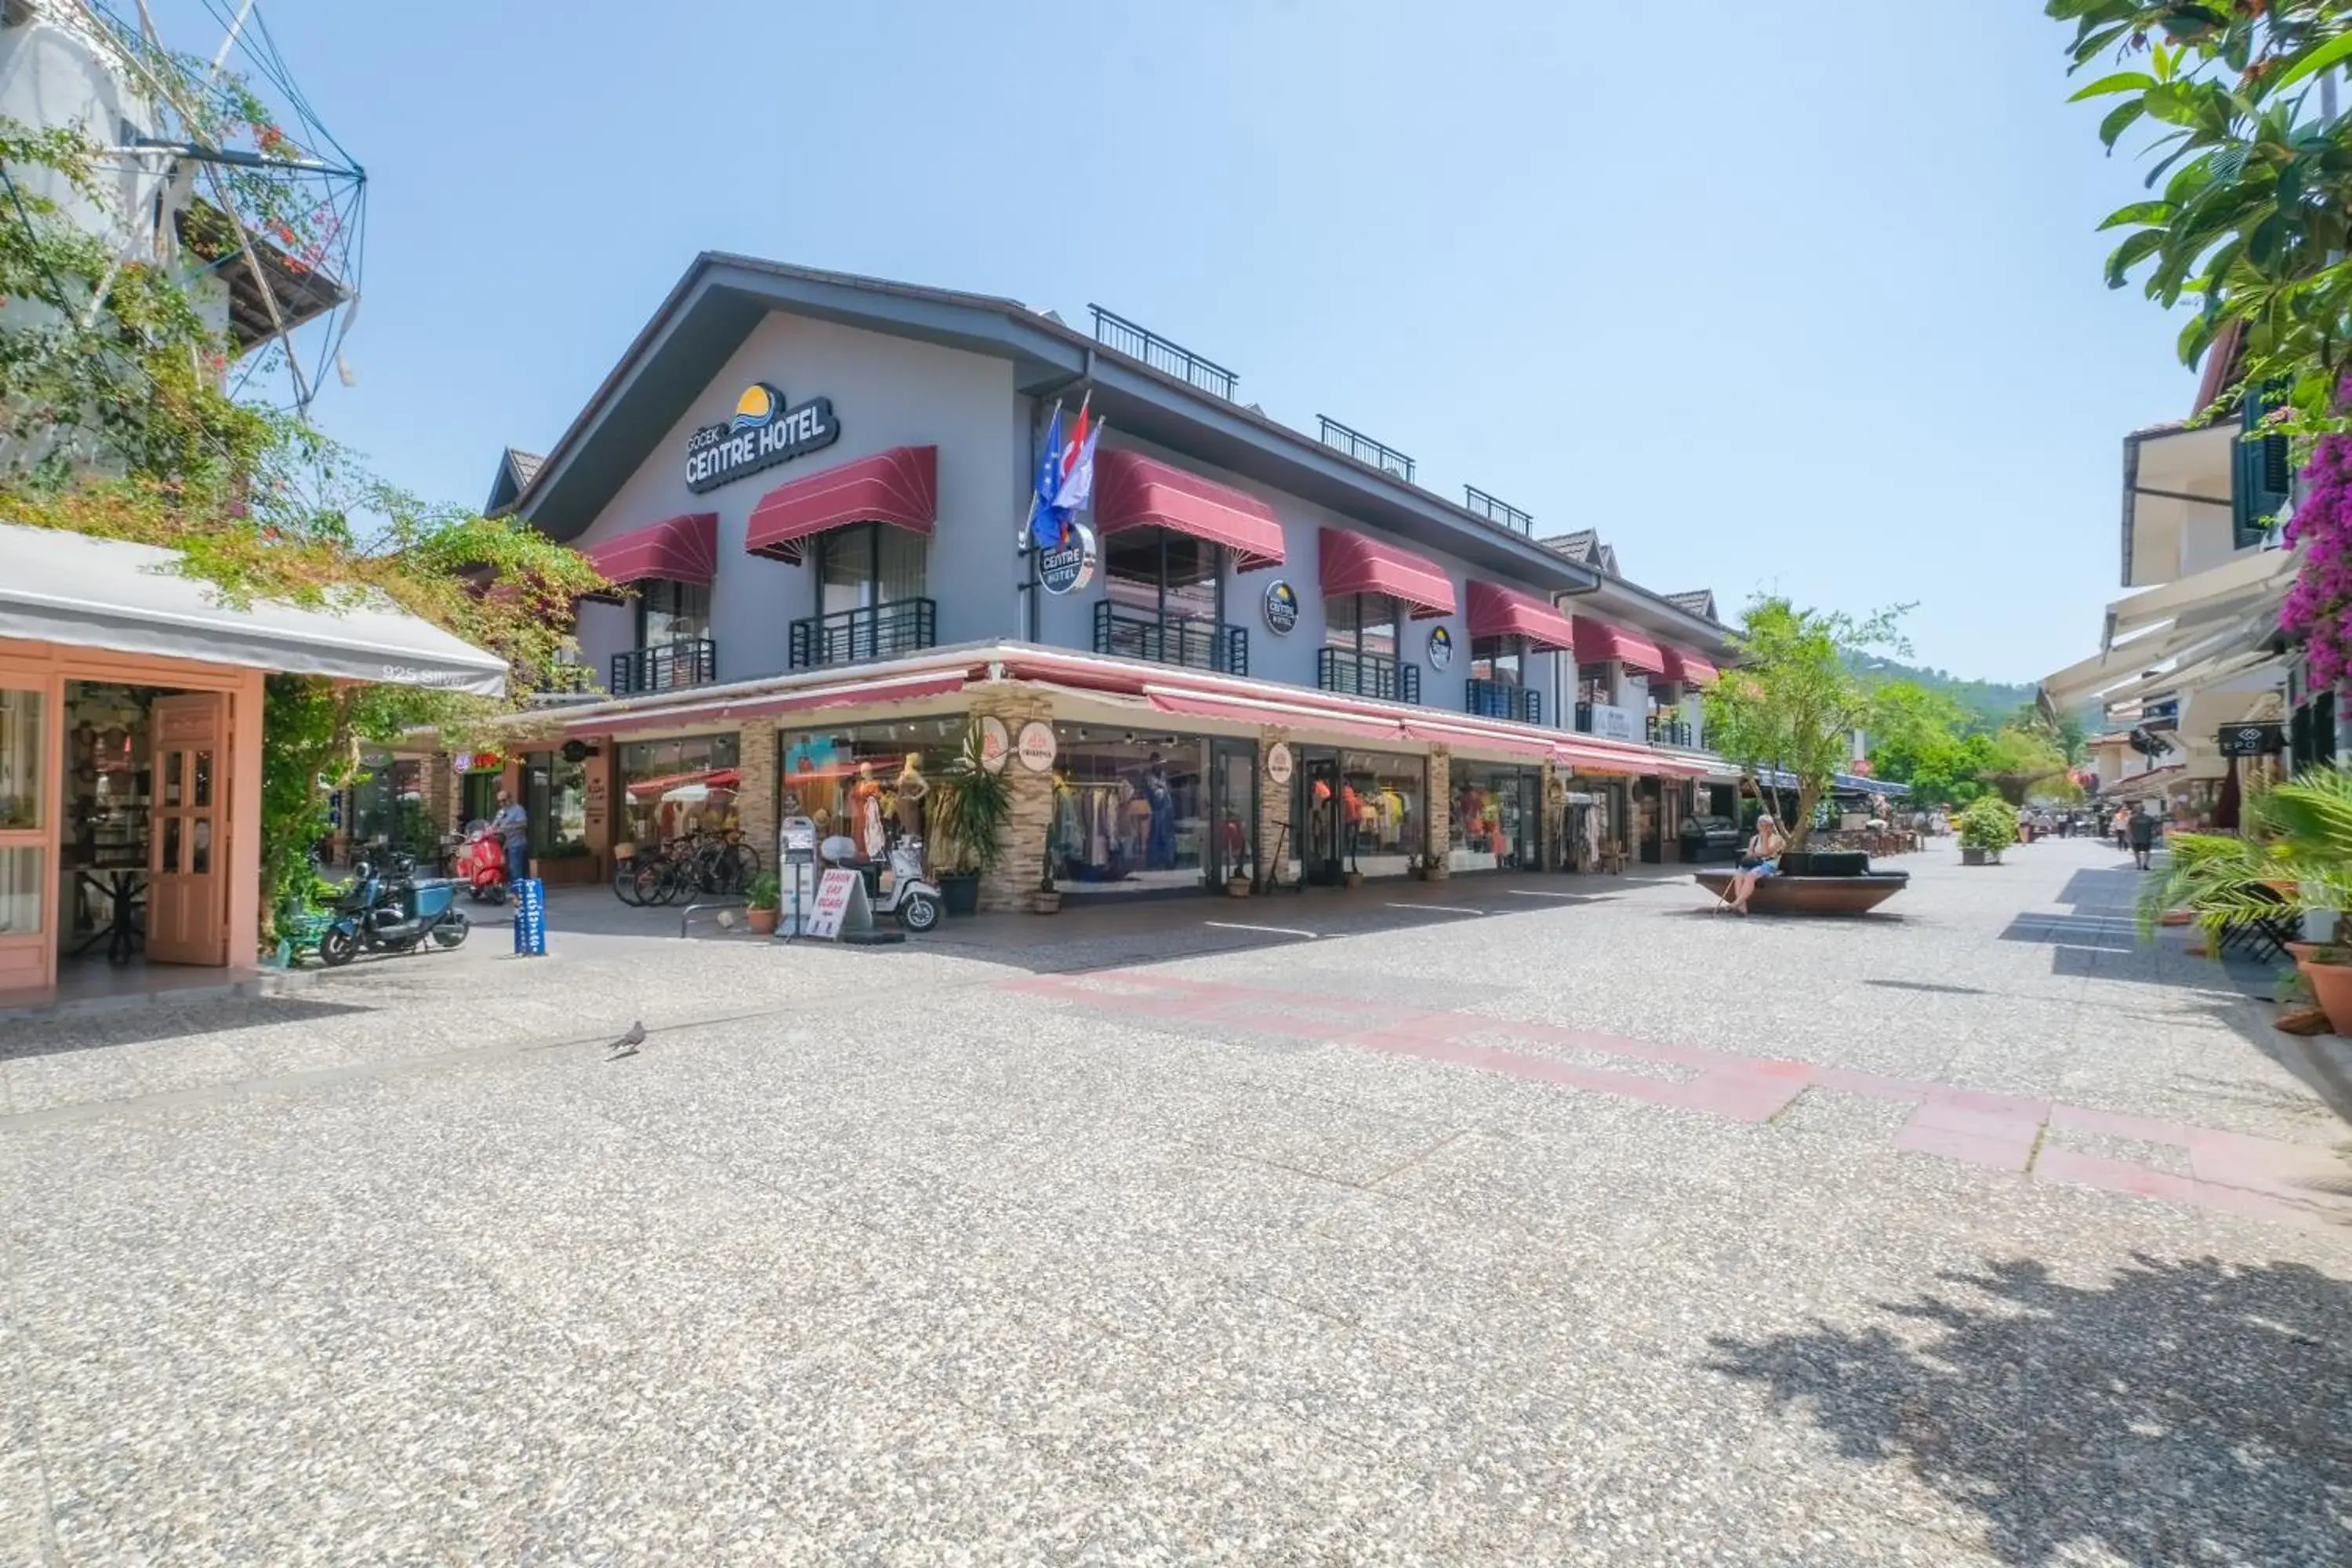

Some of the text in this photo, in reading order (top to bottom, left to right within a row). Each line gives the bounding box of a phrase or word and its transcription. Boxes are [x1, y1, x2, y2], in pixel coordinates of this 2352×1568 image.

[686, 405, 825, 483] CENTRE HOTEL
[1044, 548, 1080, 569] CENTRE
[383, 665, 468, 688] 925 Silver
